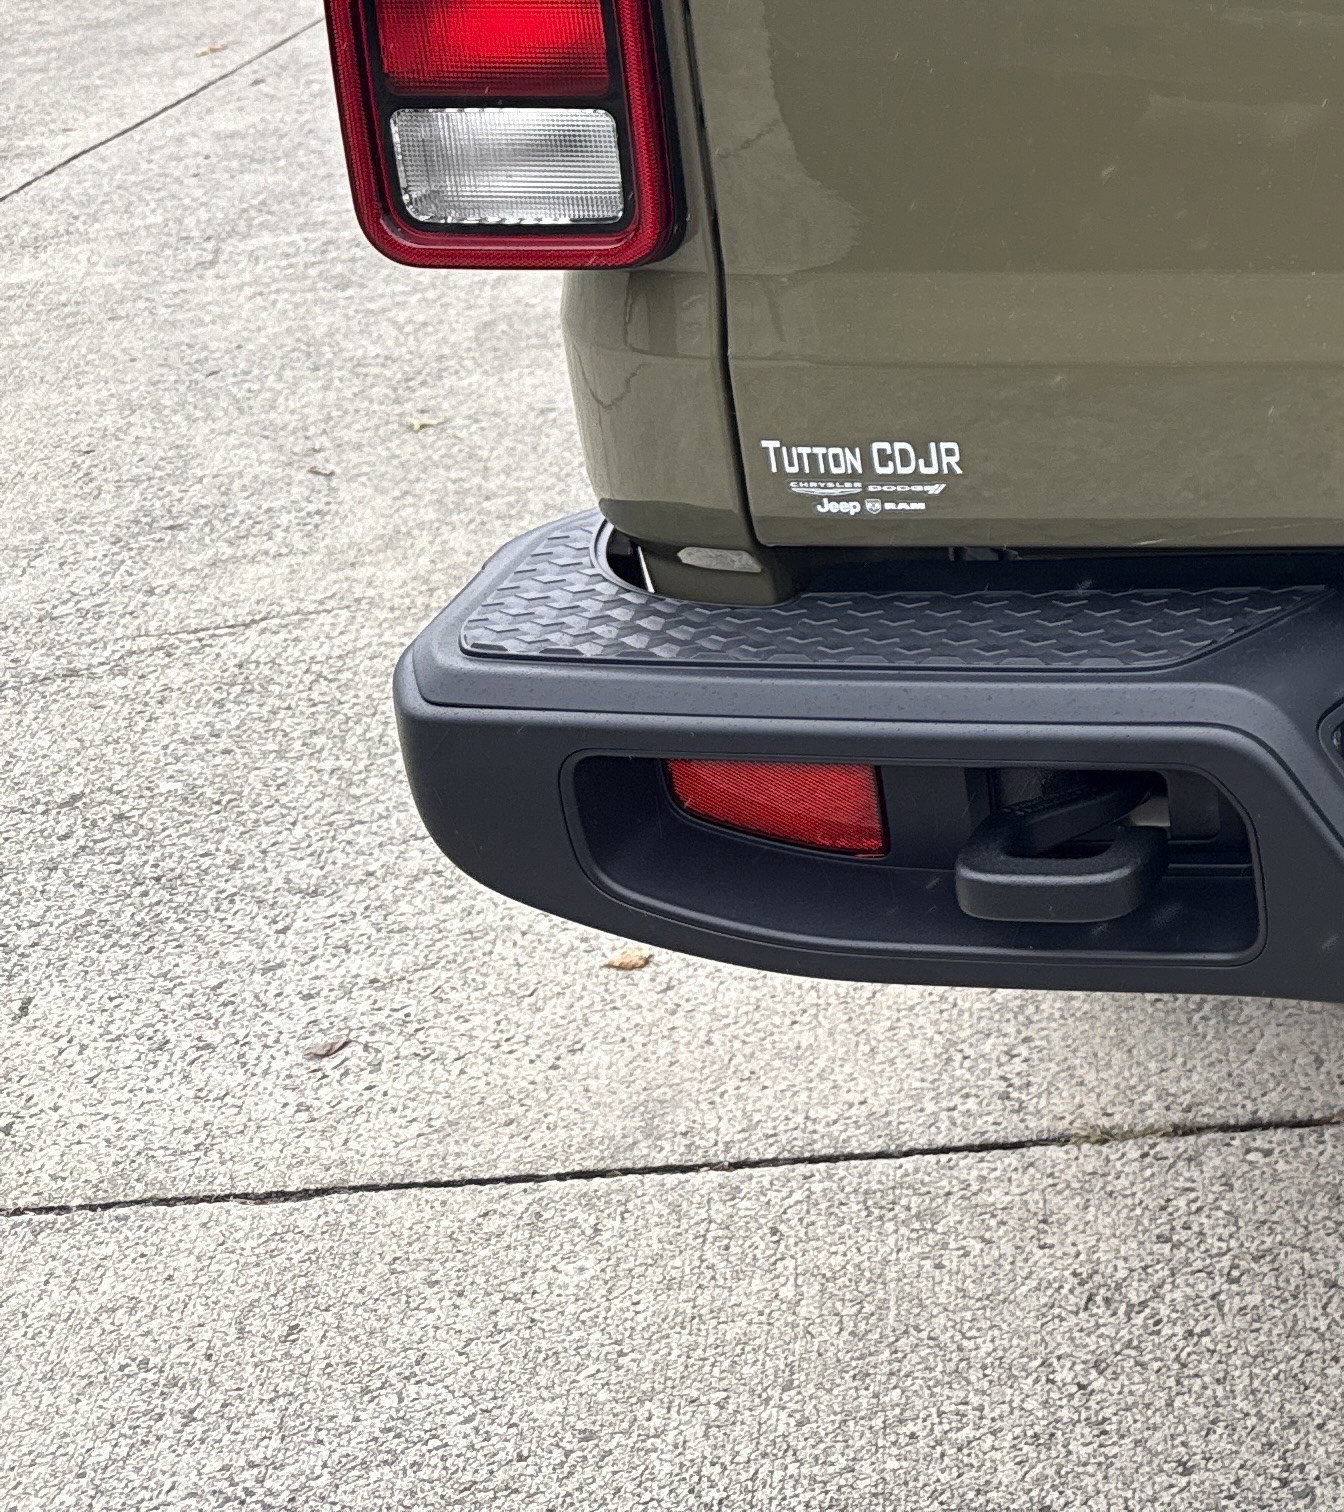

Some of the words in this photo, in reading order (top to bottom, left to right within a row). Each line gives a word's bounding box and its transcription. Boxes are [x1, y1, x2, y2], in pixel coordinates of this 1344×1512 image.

[760, 439, 863, 475] TUTTON
[871, 441, 963, 475] CDJR
[789, 481, 863, 489] CHRYSLER
[816, 497, 862, 516] Jeep
[884, 502, 926, 511] RAM
